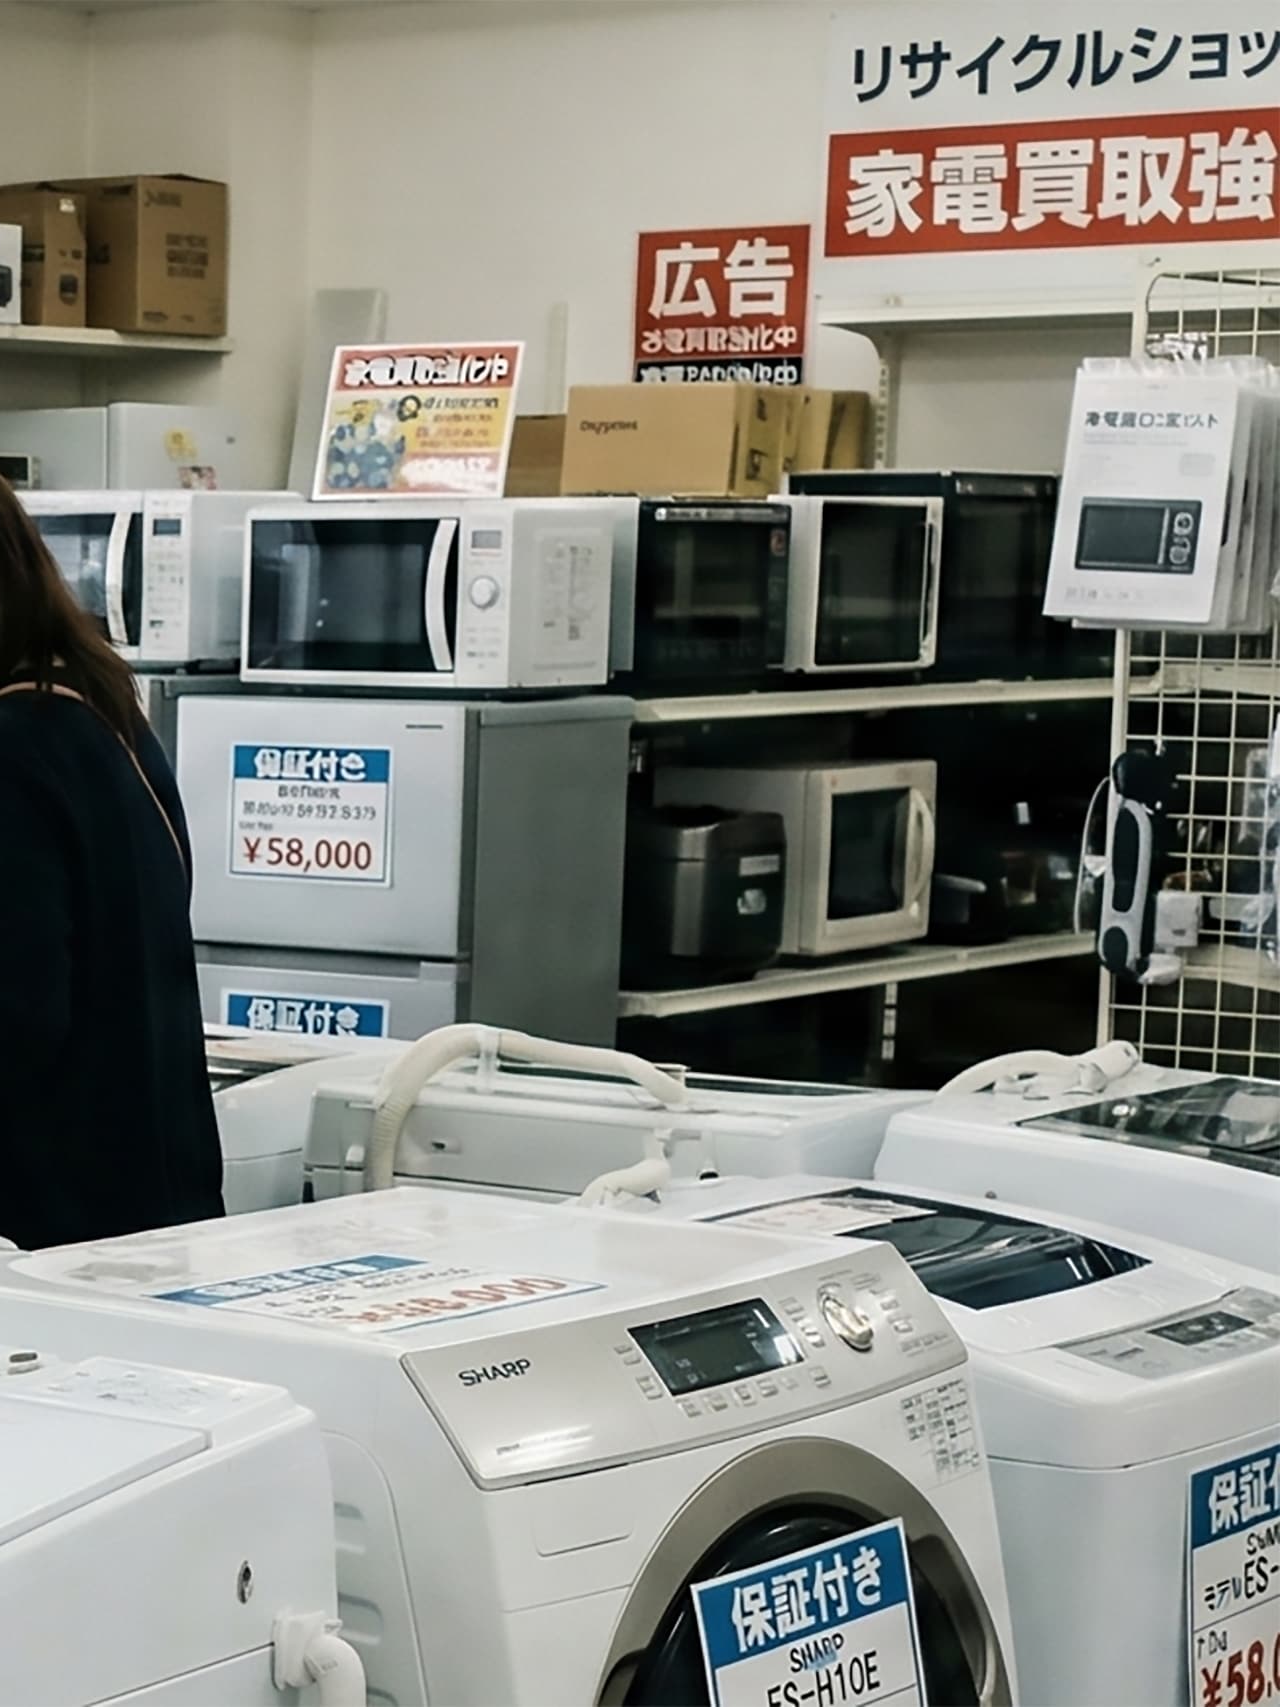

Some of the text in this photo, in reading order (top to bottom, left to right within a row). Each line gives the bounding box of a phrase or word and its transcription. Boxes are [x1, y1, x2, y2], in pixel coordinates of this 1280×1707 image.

[853, 27, 1280, 103] リサイクルショッ
[844, 127, 1278, 239] 家電買取強
[647, 237, 795, 320] 広告
[243, 837, 372, 873] ¥58,000
[457, 1357, 532, 1387] SHARP
[1207, 1452, 1280, 1535] 保証
[730, 1545, 882, 1654] 保証付き
